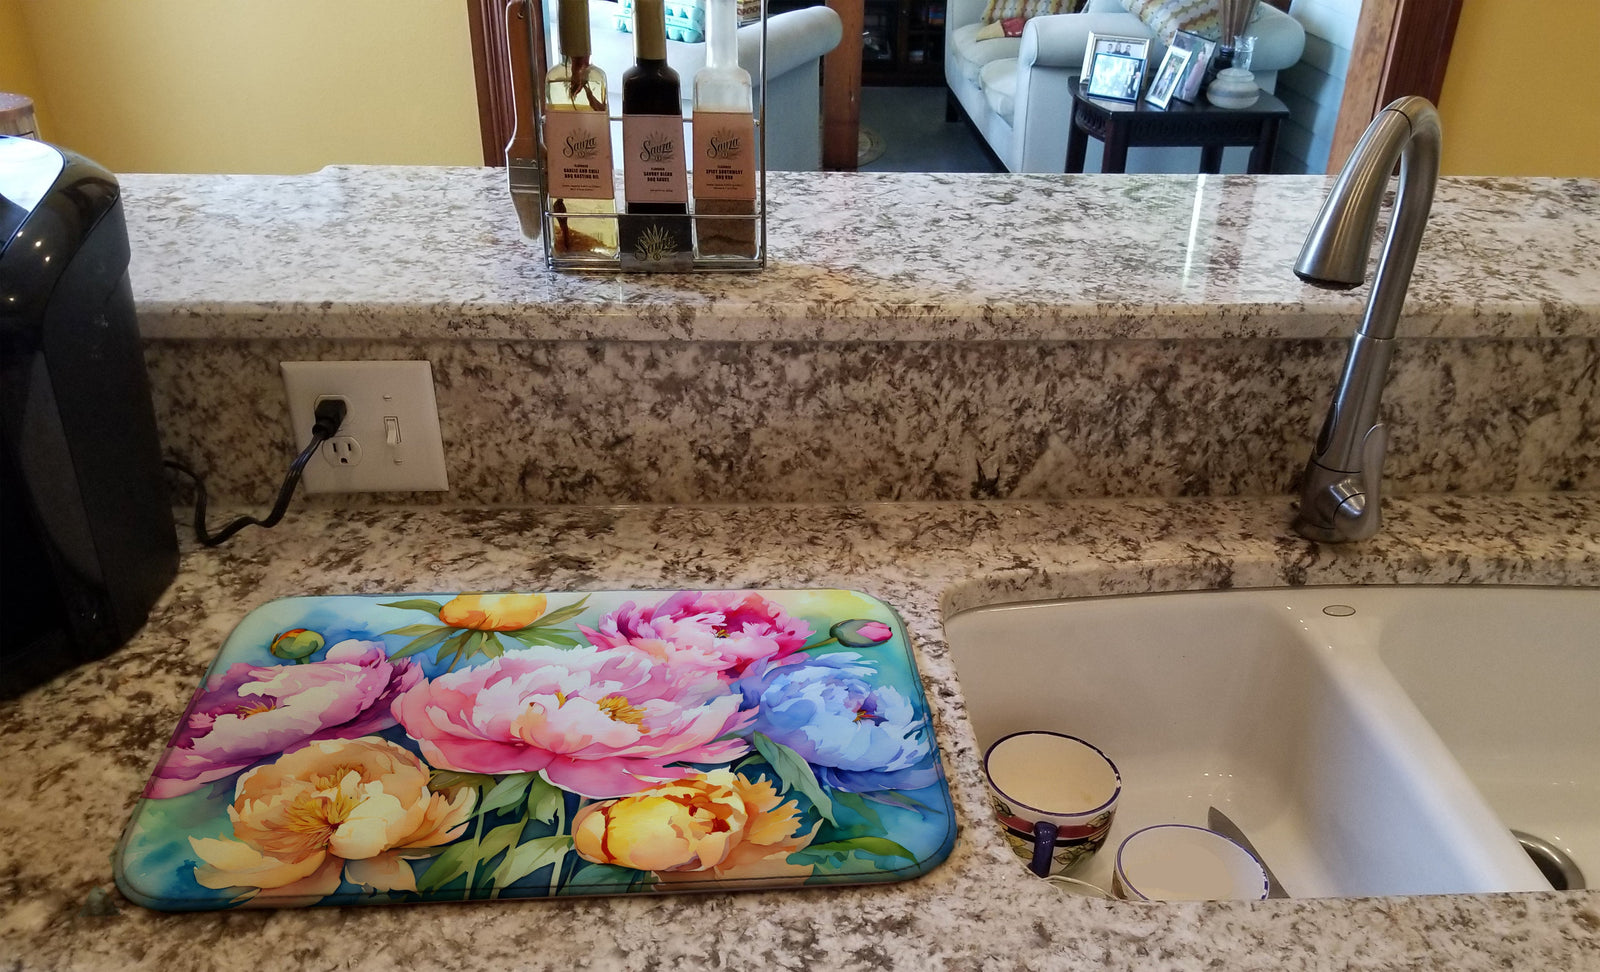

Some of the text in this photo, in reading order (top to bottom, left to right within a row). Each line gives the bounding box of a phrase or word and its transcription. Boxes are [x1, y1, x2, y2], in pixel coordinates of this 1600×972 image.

[563, 136, 597, 158] Sauza
[640, 139, 673, 161] Sauza
[707, 137, 740, 158] Sauza
